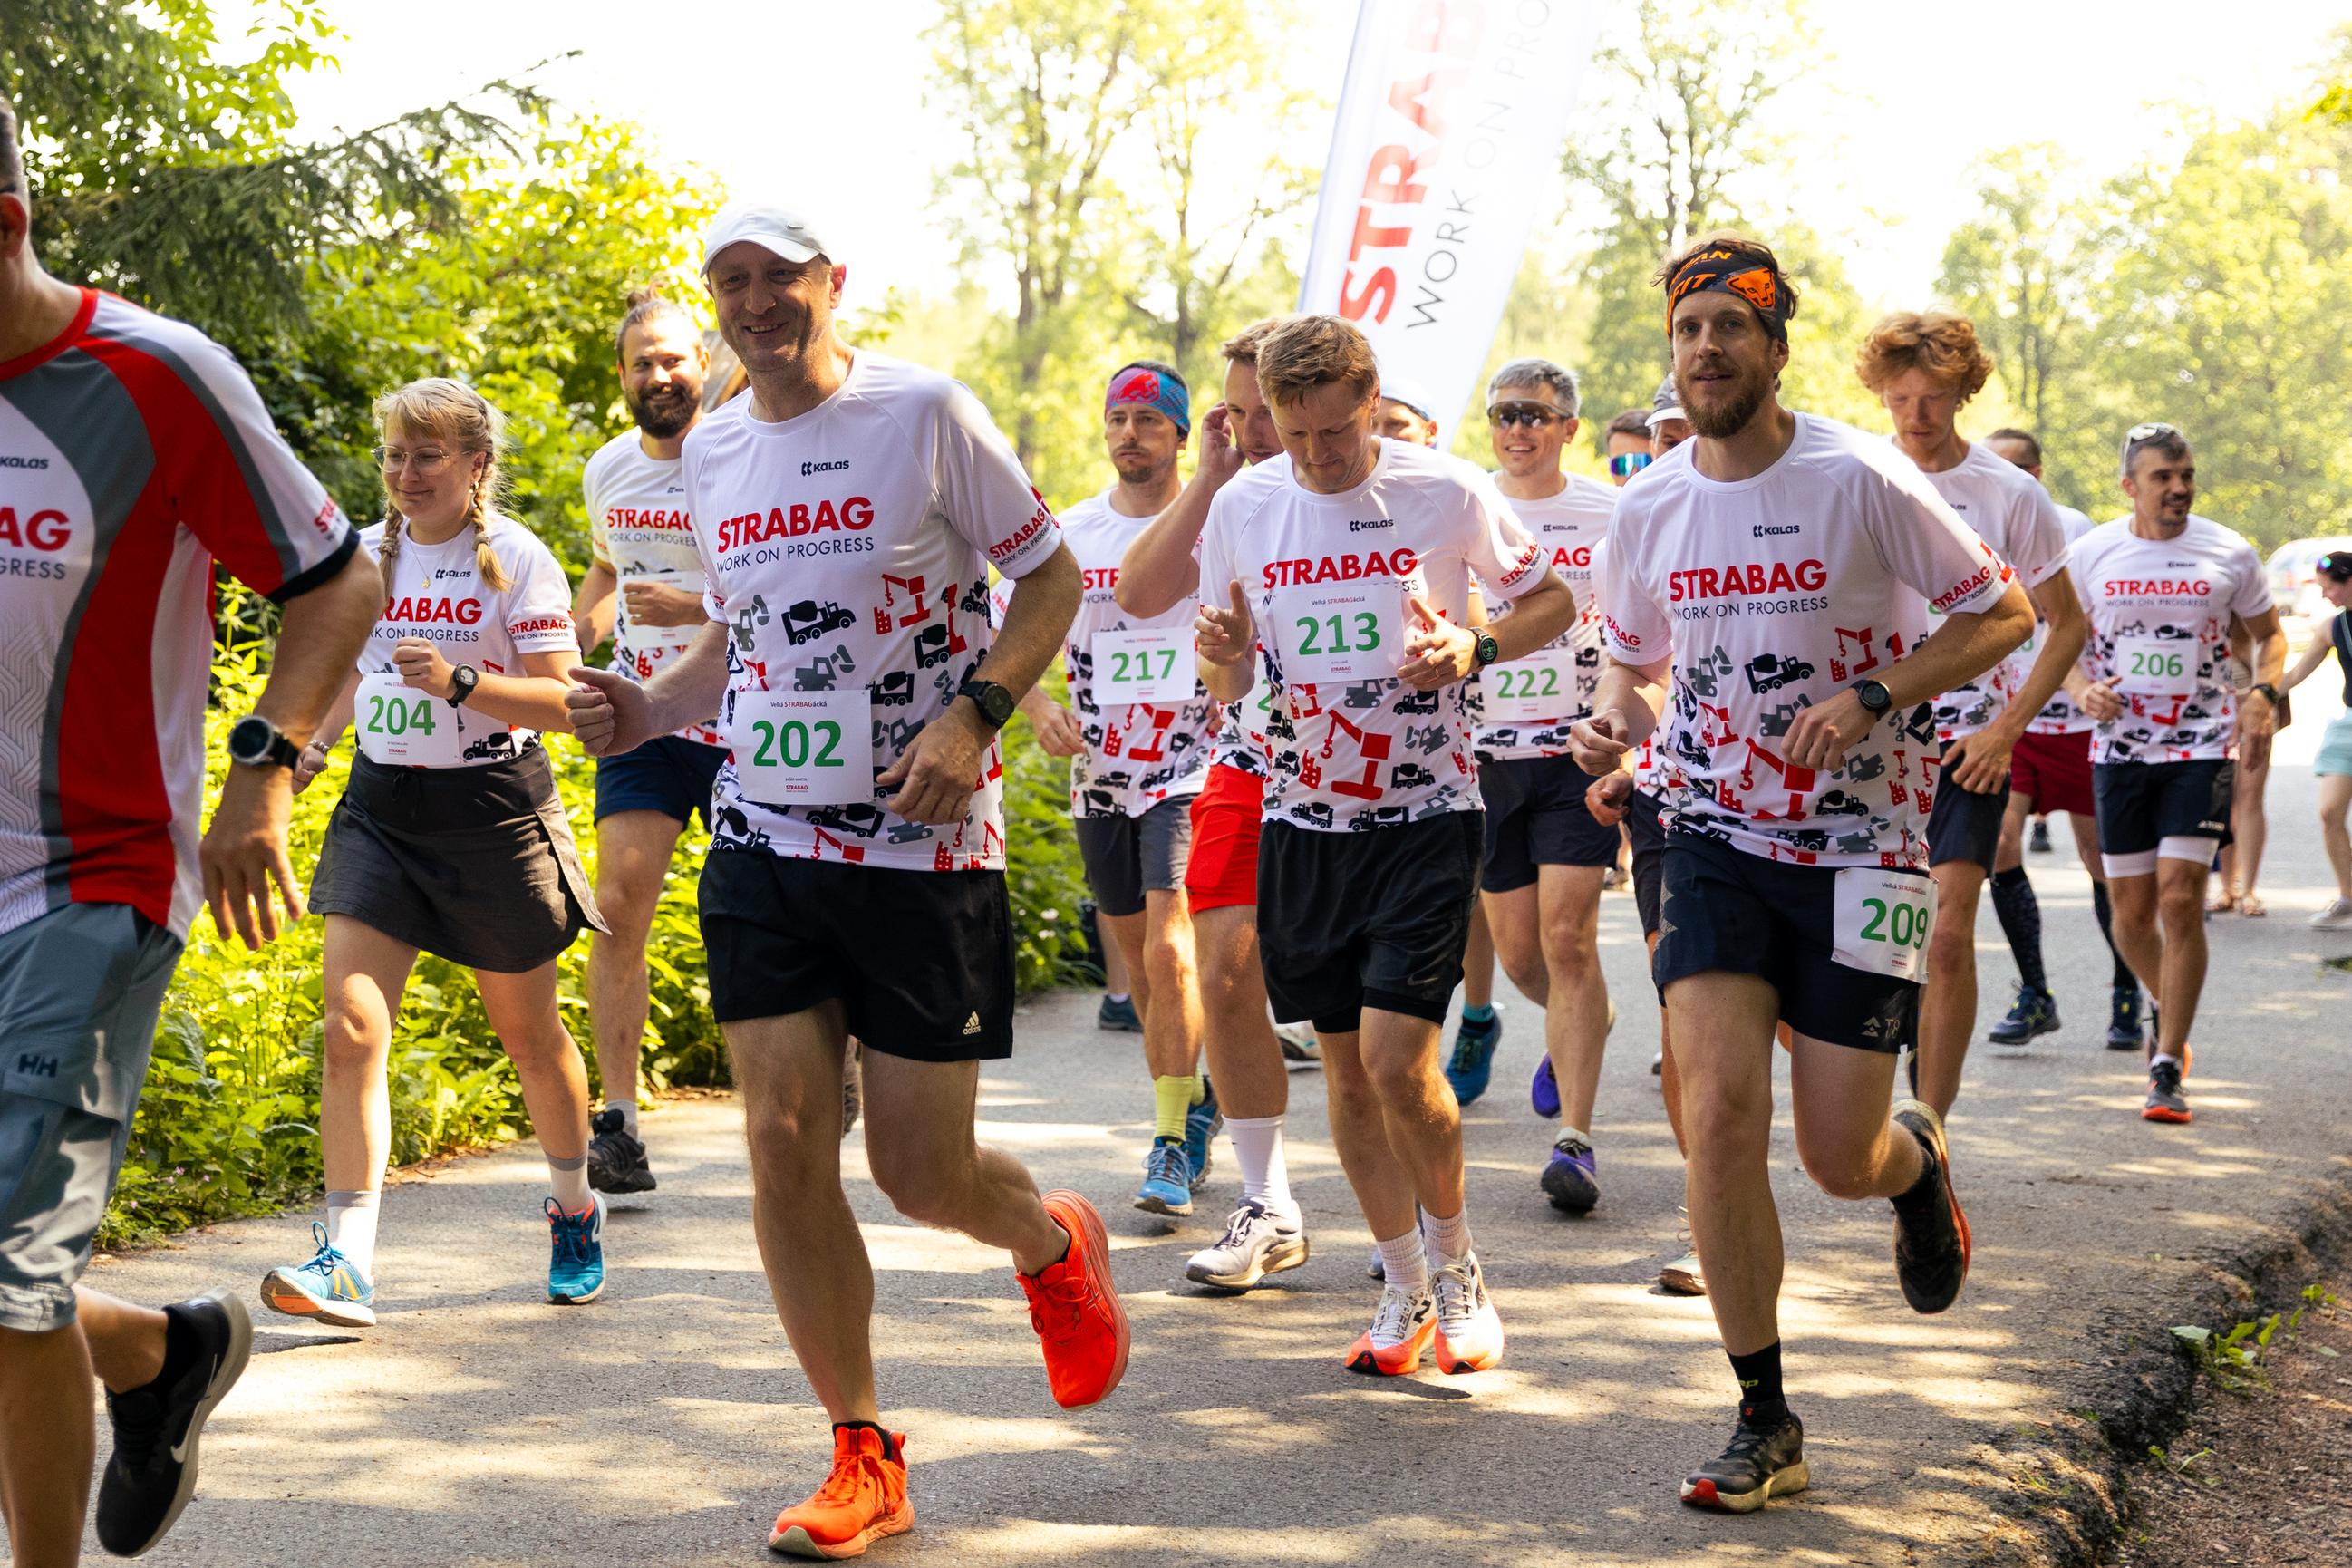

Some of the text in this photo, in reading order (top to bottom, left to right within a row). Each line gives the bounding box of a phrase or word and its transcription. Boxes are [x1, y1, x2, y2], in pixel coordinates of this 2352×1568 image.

[1339, 0, 1486, 325] STRAB
[1407, 189, 1479, 329] WORK
[634, 533, 651, 542] ON
[654, 533, 697, 547] PROGRES
[717, 496, 875, 554] STRABAG
[989, 508, 1046, 558] STRABAG
[716, 537, 875, 574] WORK ON PROGRESS
[1018, 545, 1031, 556] ON
[0, 558, 65, 580] GRESS
[1262, 547, 1418, 589] STRABAG
[1670, 558, 1827, 602] STRABAG
[2105, 580, 2211, 596] STRABAG
[2105, 598, 2210, 607] WORK ON PROGRESS
[379, 596, 483, 625] RABAG
[1716, 604, 1740, 616] ON
[1747, 596, 1829, 615] PROGRESS
[386, 627, 405, 640] ON
[411, 627, 479, 642] PROGRESS
[508, 619, 568, 634] STRABAG
[1296, 612, 1381, 656] 213
[1111, 649, 1176, 682] 217
[2131, 652, 2183, 677] 206
[1496, 667, 1560, 699] 222
[367, 695, 436, 736] 204
[752, 720, 845, 768] 202
[1860, 898, 1929, 950] 209
[17, 1053, 58, 1079] HH
